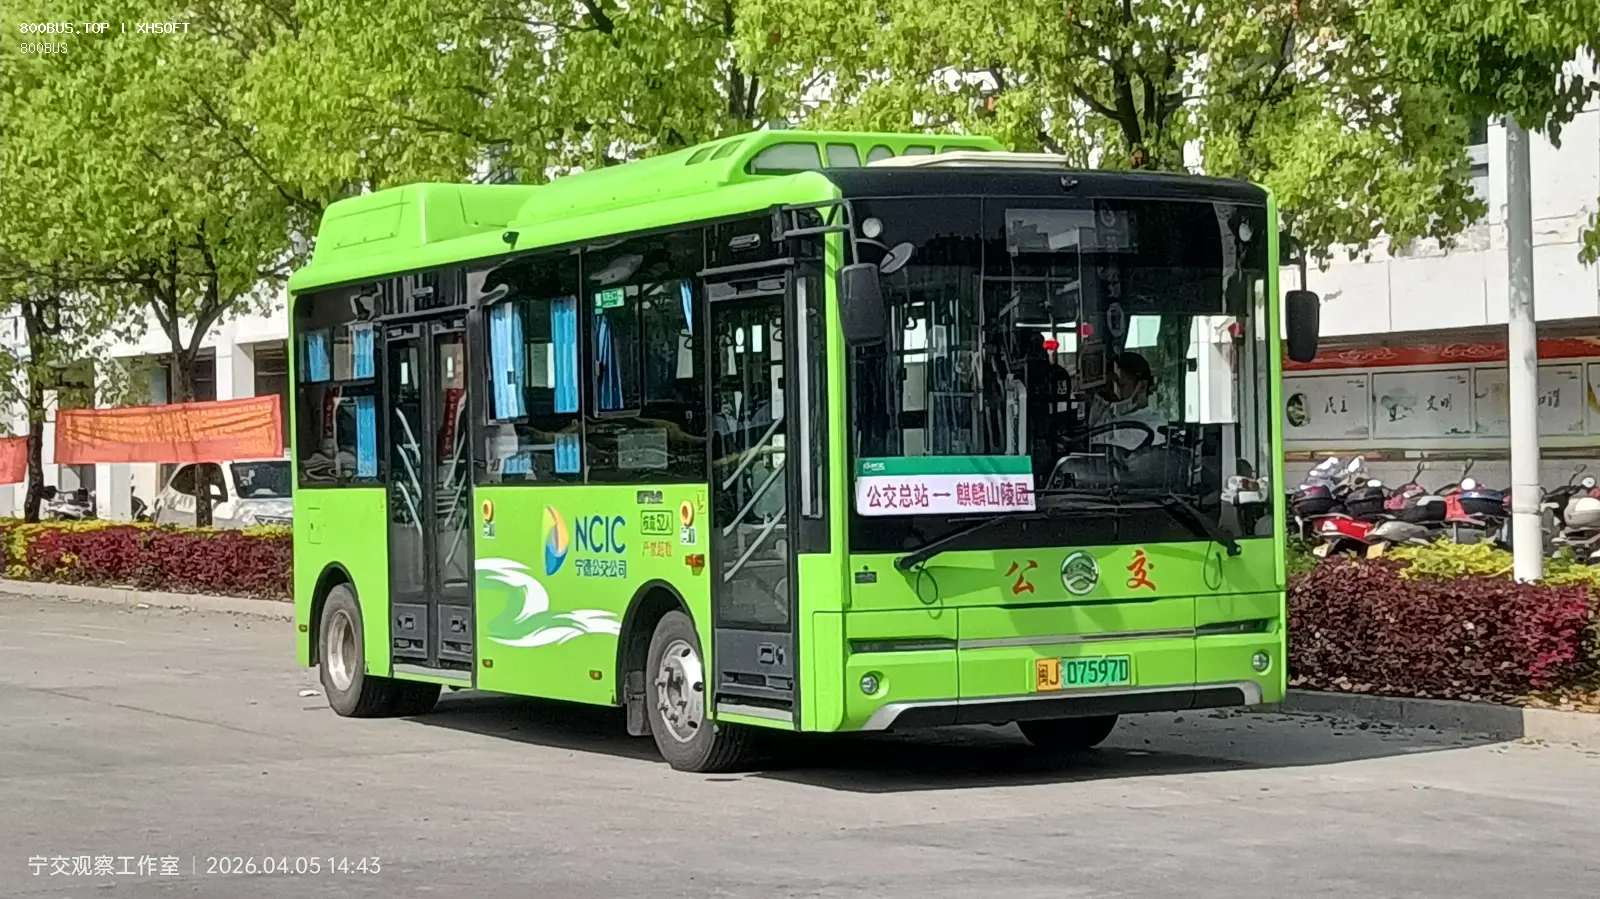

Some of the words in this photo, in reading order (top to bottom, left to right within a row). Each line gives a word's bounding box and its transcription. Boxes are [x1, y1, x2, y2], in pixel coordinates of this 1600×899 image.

[1426, 394, 1453, 412] 文明
[866, 483, 929, 508] 公交总站
[956, 482, 1030, 507] 麒麟山陵园
[575, 515, 626, 554] NCIC
[575, 559, 627, 579] 宁德公交公司
[1005, 560, 1038, 595] 公
[1125, 549, 1157, 592] 交
[1038, 661, 1059, 686] 闽J
